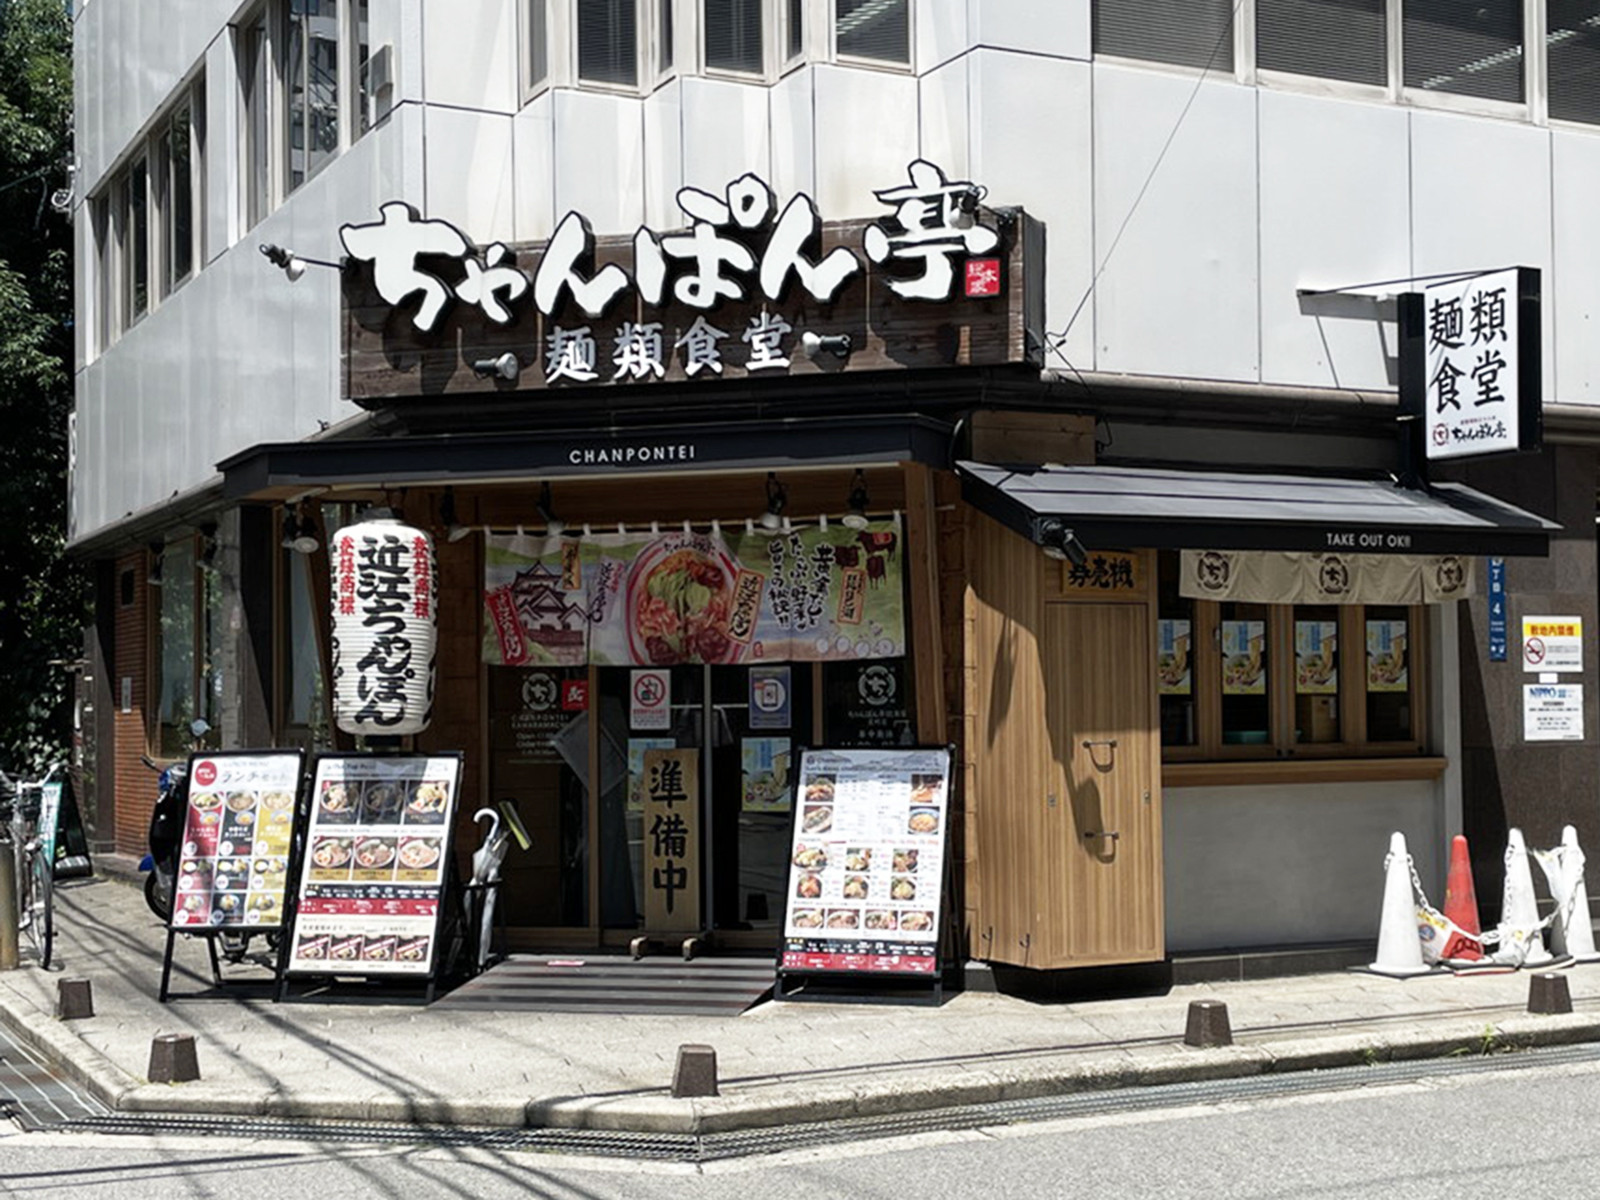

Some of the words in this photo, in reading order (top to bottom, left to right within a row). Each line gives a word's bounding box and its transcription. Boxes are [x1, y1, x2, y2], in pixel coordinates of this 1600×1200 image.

[340, 159, 999, 331] ちゃんぽん亭
[544, 311, 793, 384] 麺類食堂
[1428, 287, 1508, 356] 麺類
[1428, 350, 1508, 414] 食堂
[569, 445, 694, 464] CHANPONTEI
[1326, 533, 1355, 546] TAKE
[1359, 533, 1383, 547] OUT
[650, 759, 688, 915] 準備中
